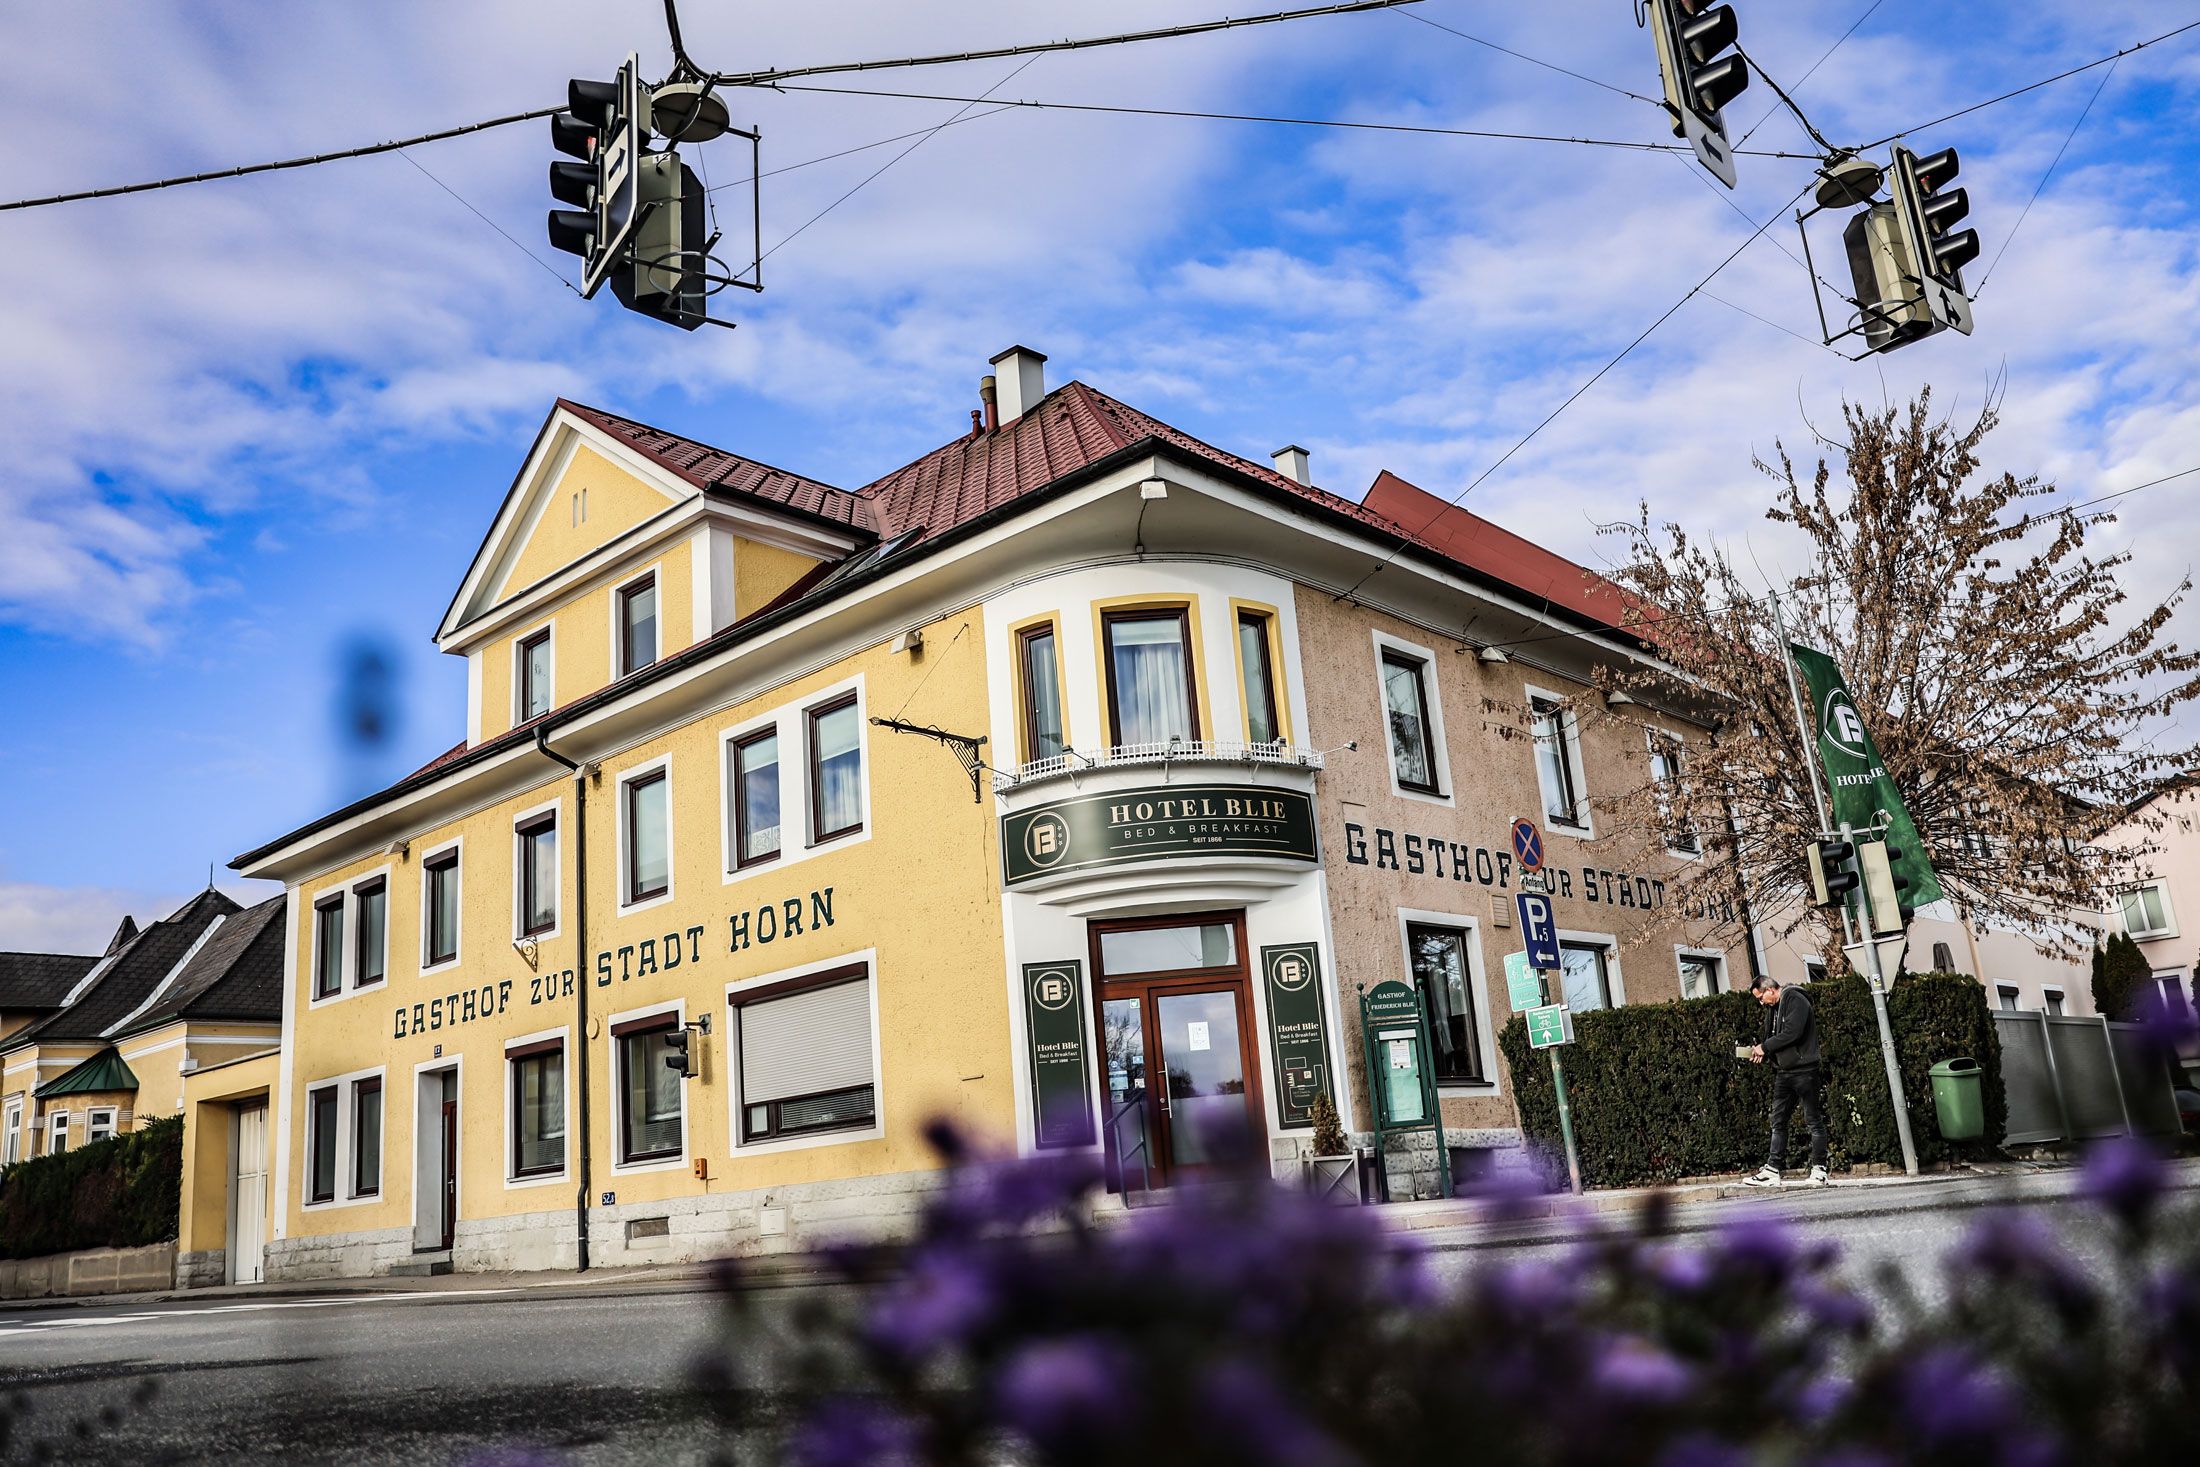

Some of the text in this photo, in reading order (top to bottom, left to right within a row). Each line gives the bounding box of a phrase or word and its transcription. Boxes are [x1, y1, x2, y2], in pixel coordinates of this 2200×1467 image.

[1836, 774, 1872, 787] HOTE
[1110, 798, 1286, 824] HOTEL BLIE
[1124, 824, 1279, 839] BED & BREAKFAST
[1345, 822, 1511, 888] GASTHOF
[1541, 866, 1573, 898] UR
[1583, 867, 1666, 910] STADT
[394, 887, 835, 1039] GASTHOF ZUR STADT HORN
[1278, 1022, 1319, 1033] Hotel Blie
[1037, 1041, 1079, 1052] Hotel Blie
